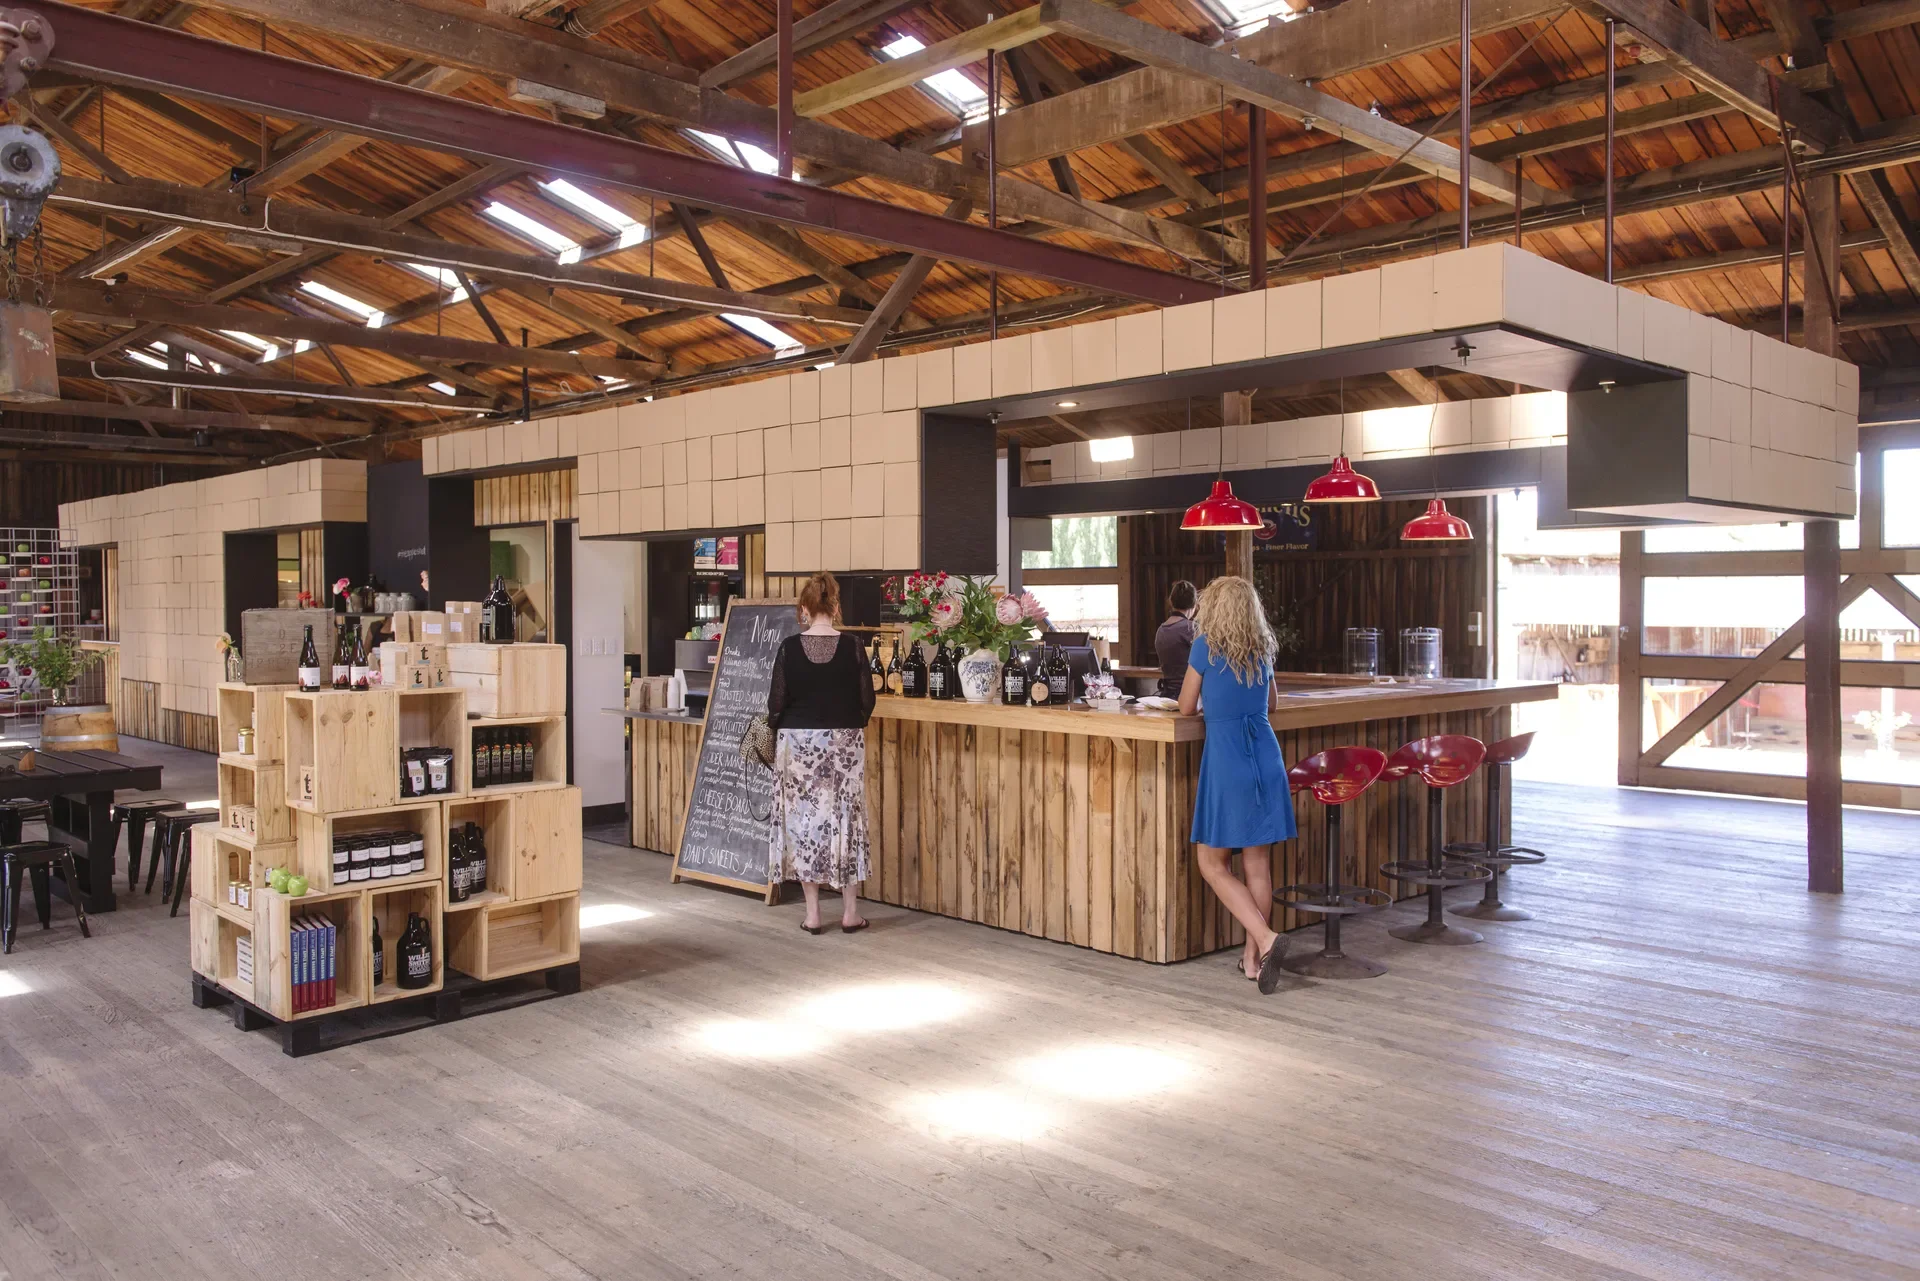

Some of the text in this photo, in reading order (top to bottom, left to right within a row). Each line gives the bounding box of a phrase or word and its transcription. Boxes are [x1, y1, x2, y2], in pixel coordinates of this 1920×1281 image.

[746, 614, 782, 650] Menu
[720, 689, 744, 703] TOASTED
[698, 788, 725, 810] CHEESE
[683, 843, 709, 865] DAILY
[708, 847, 740, 873] SWEETS
